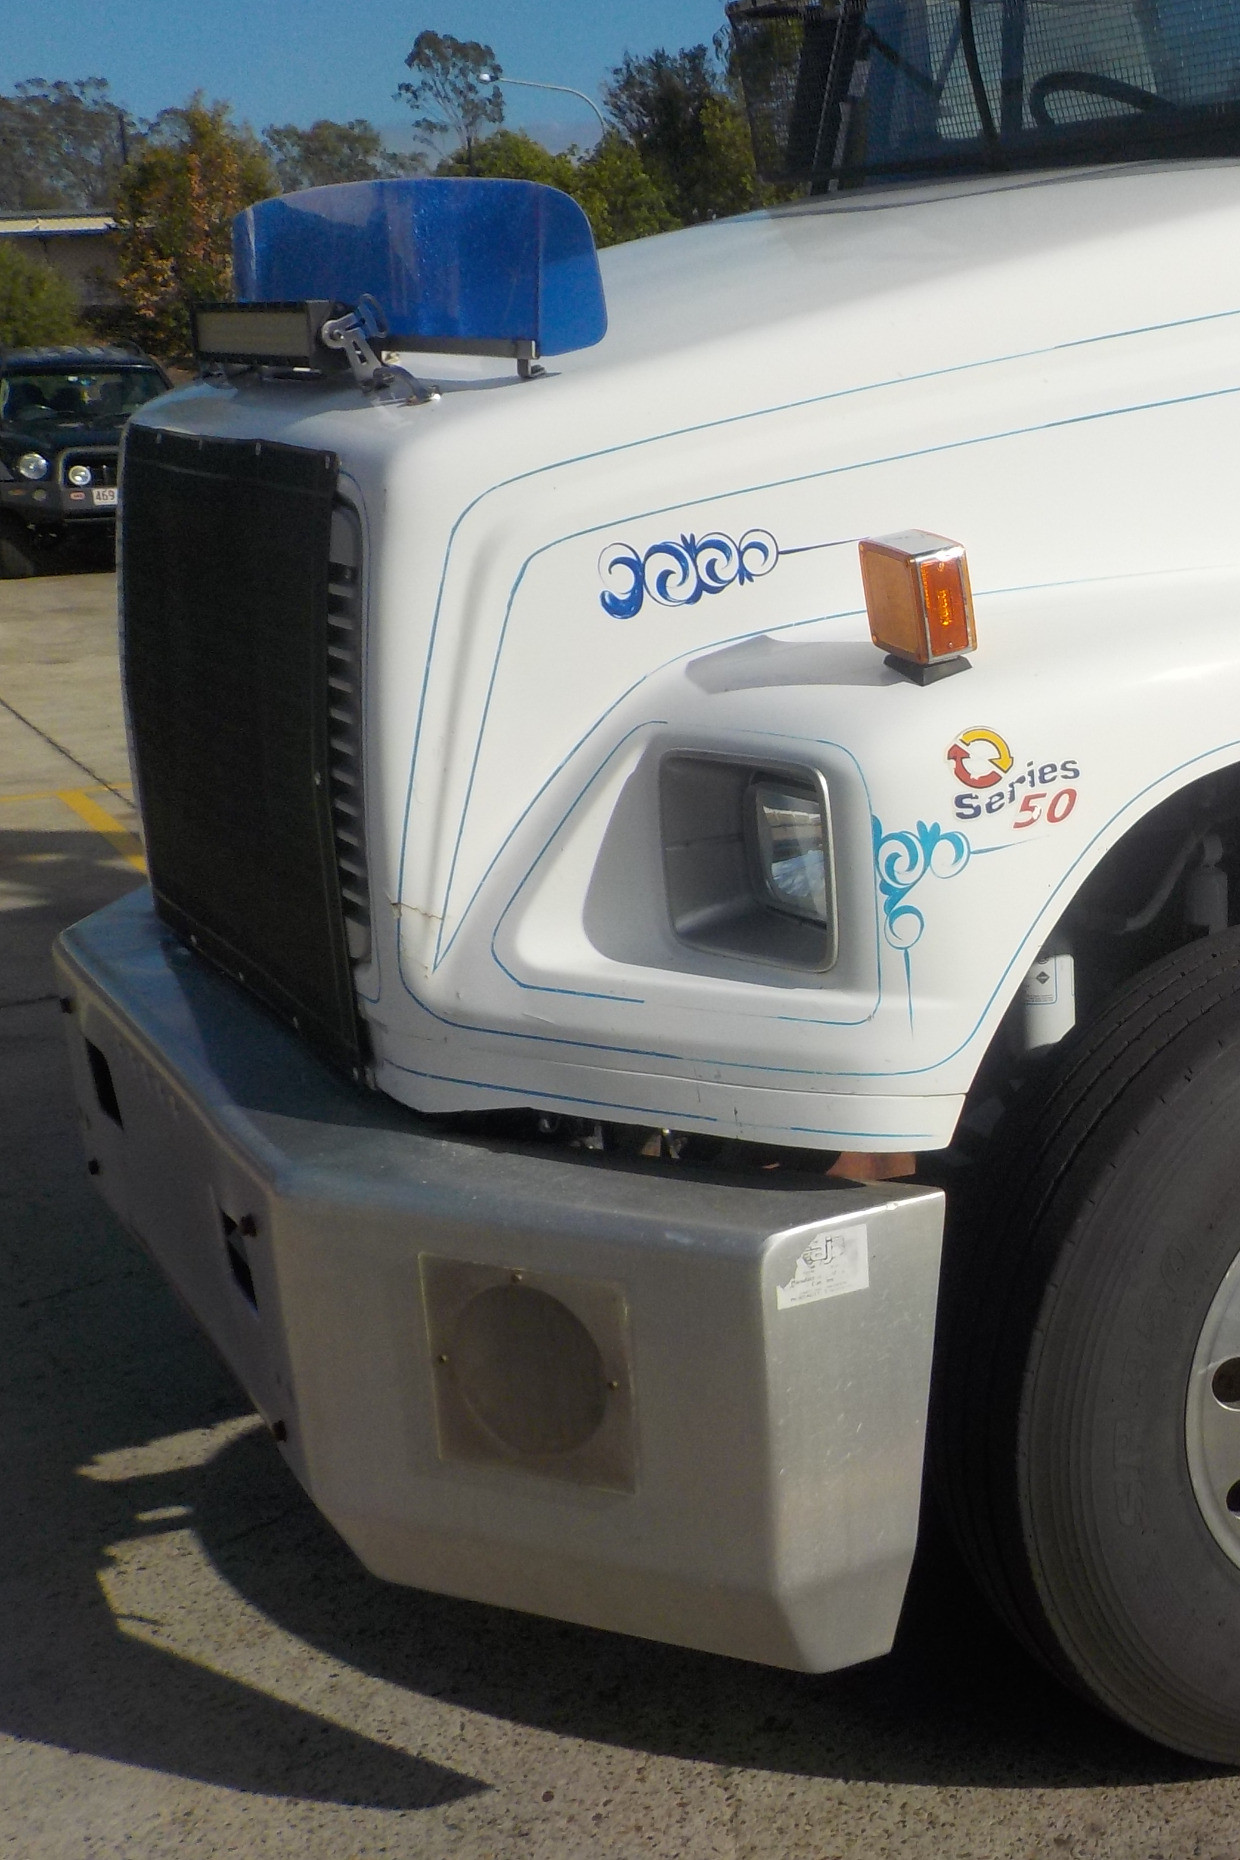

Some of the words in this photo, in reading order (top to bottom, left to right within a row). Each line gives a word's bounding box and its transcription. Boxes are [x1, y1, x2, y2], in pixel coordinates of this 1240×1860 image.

[95, 490, 115, 501] 469
[954, 759, 1080, 820] Series
[1012, 787, 1078, 829] 50
